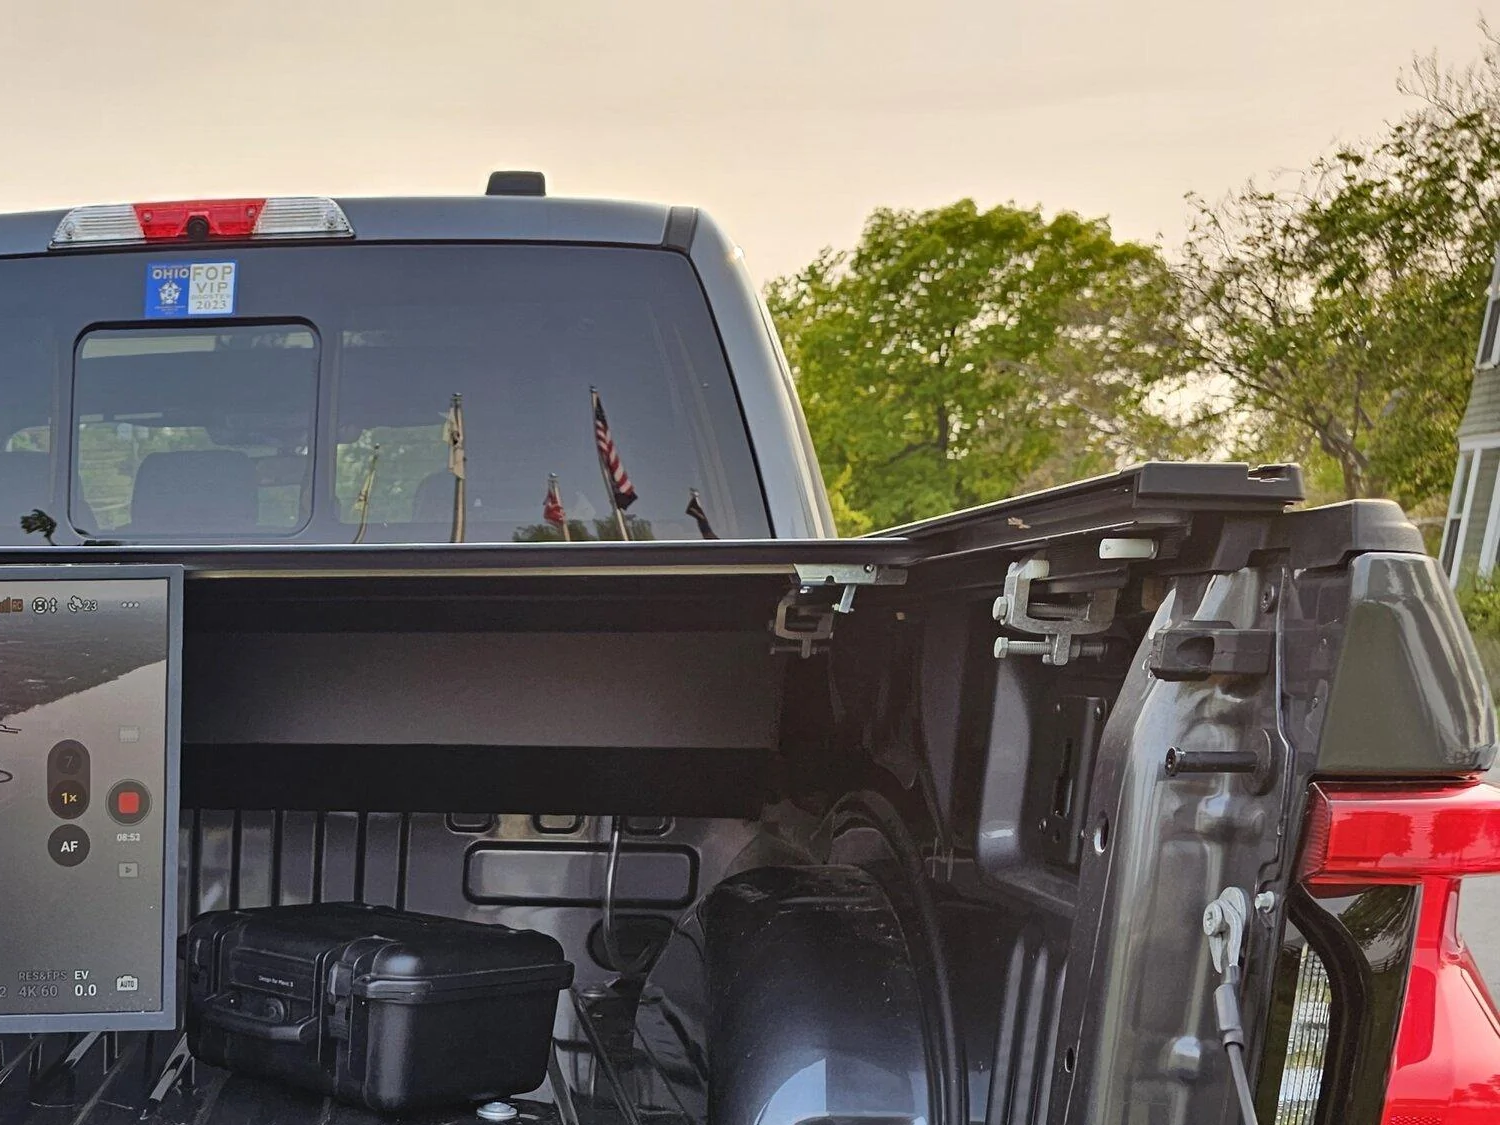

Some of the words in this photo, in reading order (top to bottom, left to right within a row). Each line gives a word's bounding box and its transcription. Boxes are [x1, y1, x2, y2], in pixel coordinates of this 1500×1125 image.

[152, 268, 189, 280] OHIO
[192, 265, 233, 281] FOP
[196, 282, 228, 294] VIP
[196, 300, 227, 311] 2023
[84, 600, 98, 612] 23
[60, 840, 78, 853] AF
[74, 970, 90, 980] EV
[18, 985, 38, 997] 4K
[41, 984, 58, 997] 60
[74, 983, 98, 997] 0.0
